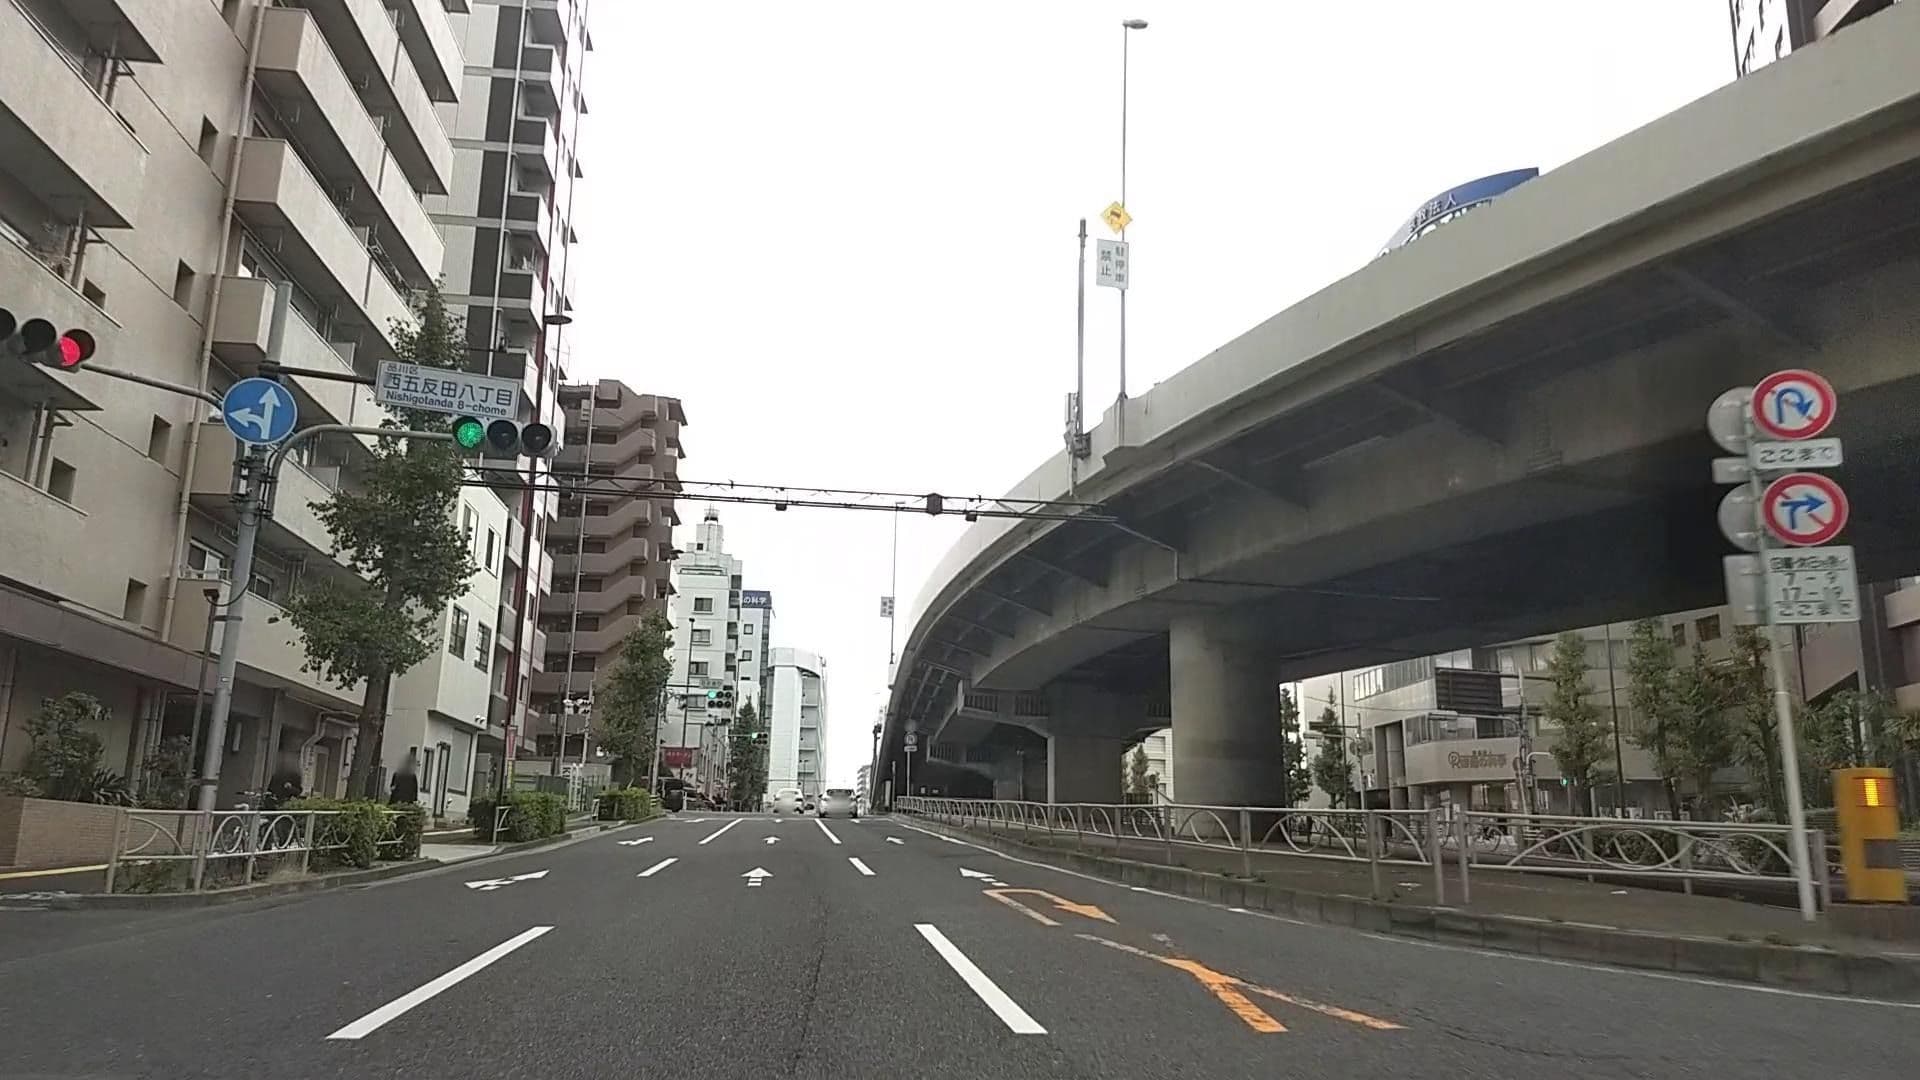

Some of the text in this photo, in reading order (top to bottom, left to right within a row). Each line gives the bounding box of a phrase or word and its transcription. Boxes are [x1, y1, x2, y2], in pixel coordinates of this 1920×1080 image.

[387, 363, 418, 376] 品川区
[383, 372, 512, 406] 西五反田八丁目
[386, 390, 507, 416] Nishigotanda 8-chome
[1760, 446, 1835, 464] ここまで
